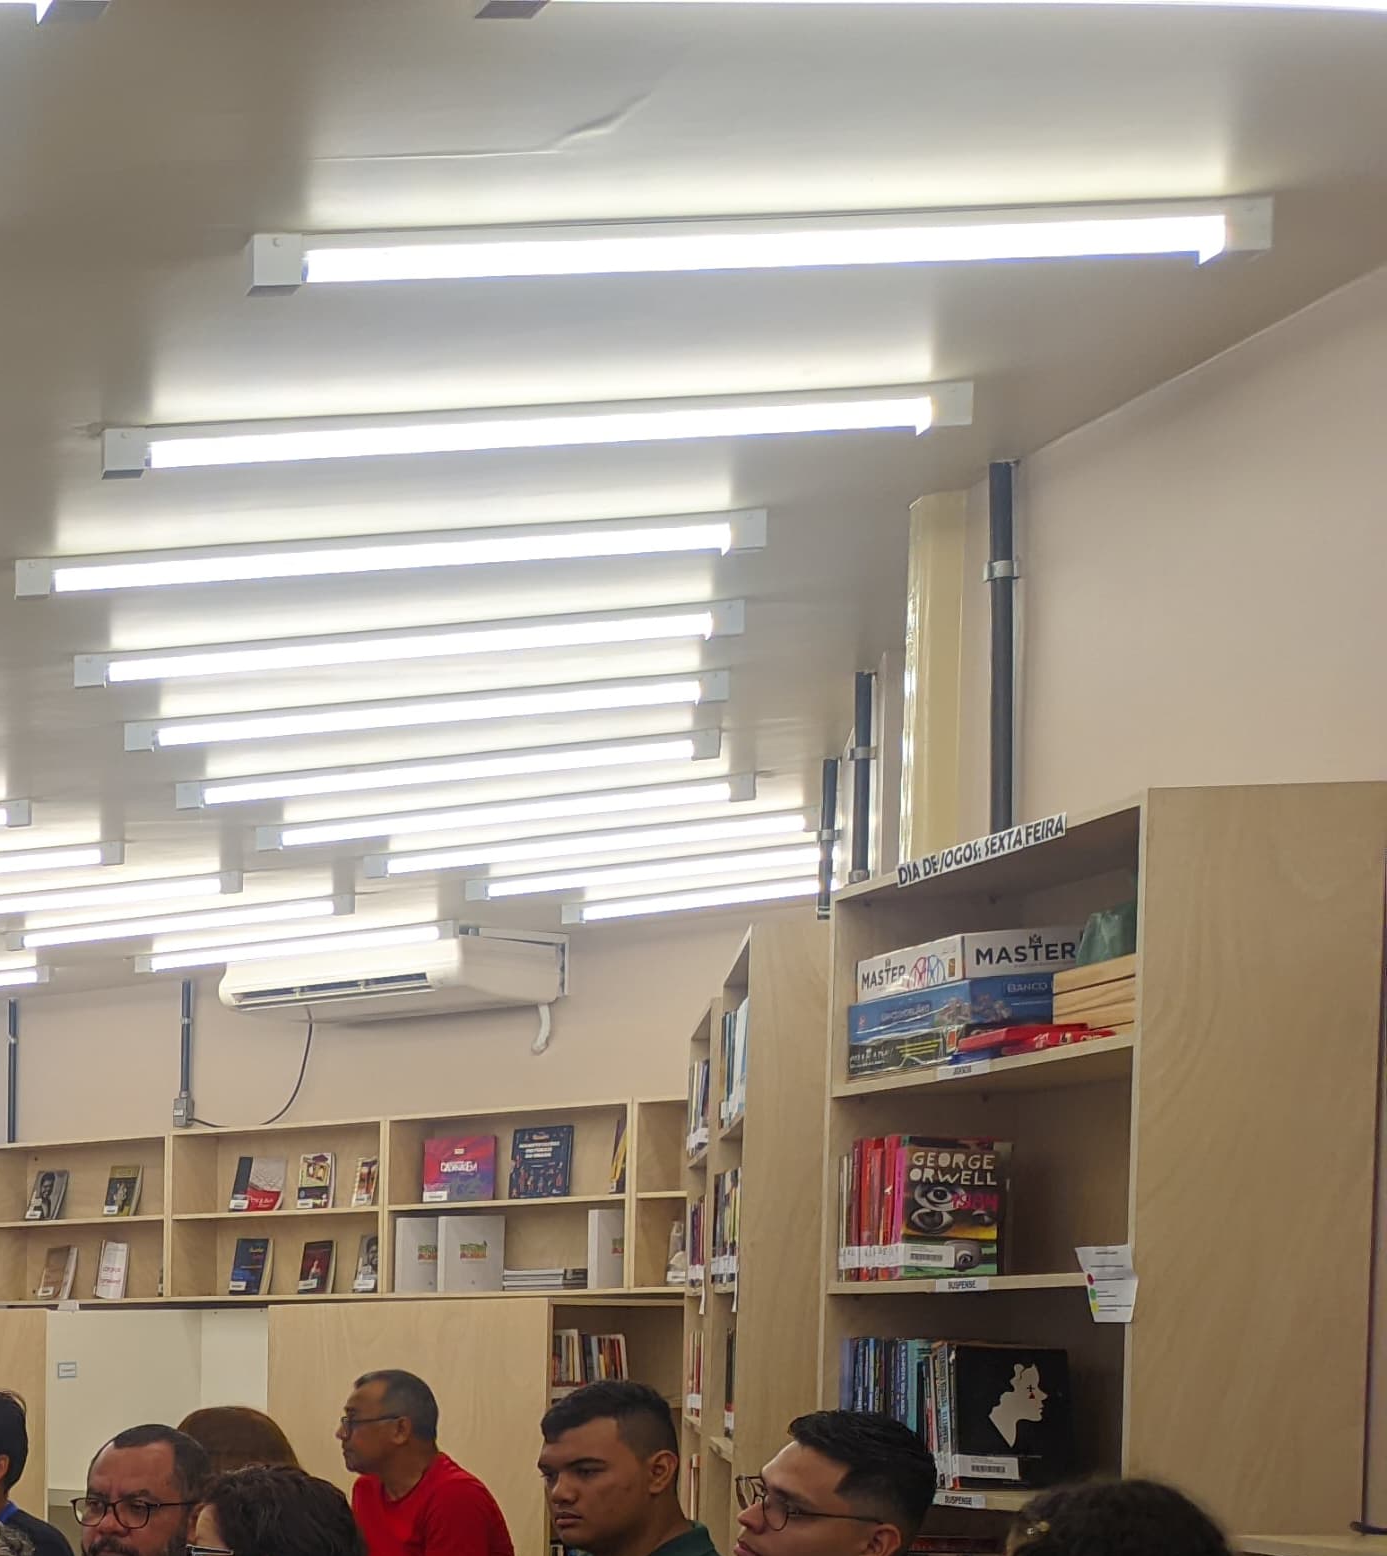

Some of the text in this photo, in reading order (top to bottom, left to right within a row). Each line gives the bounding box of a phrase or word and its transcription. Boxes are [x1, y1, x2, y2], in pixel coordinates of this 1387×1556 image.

[898, 814, 1064, 886] DIA DE JOGOS: SEXTA FEIRA
[976, 942, 1076, 966] MASTER
[912, 1151, 996, 1169] GEORGE
[909, 1168, 997, 1185] ORWELL
